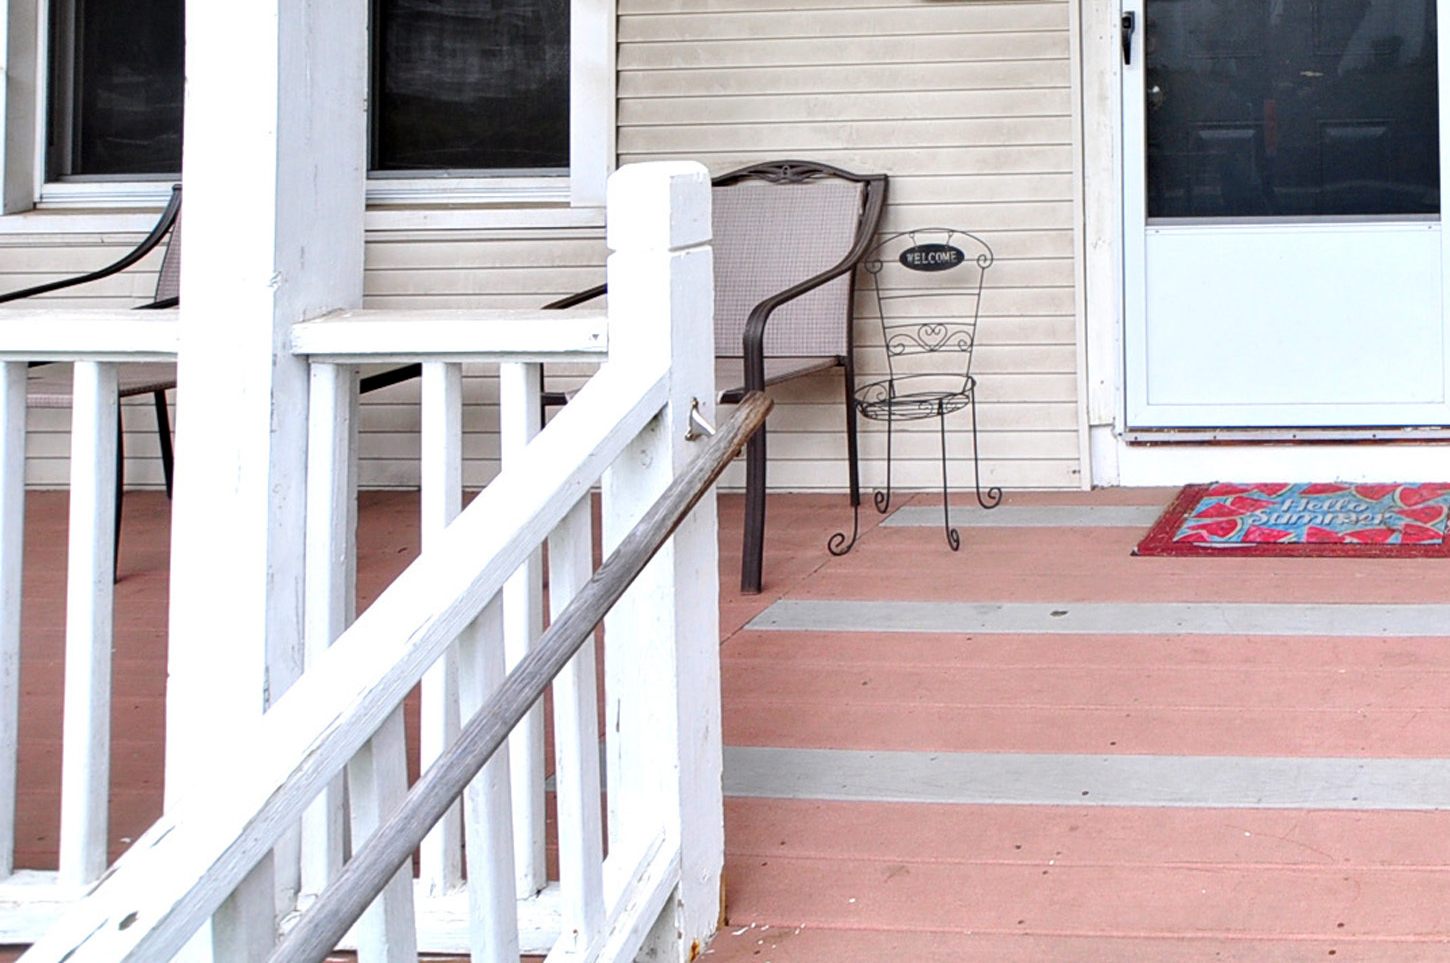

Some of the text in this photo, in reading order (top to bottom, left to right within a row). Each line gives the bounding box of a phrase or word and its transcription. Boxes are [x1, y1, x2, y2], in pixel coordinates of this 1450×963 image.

[905, 251, 958, 265] WELCOME
[1280, 498, 1368, 513] Hello
[1248, 509, 1396, 526] Summer
